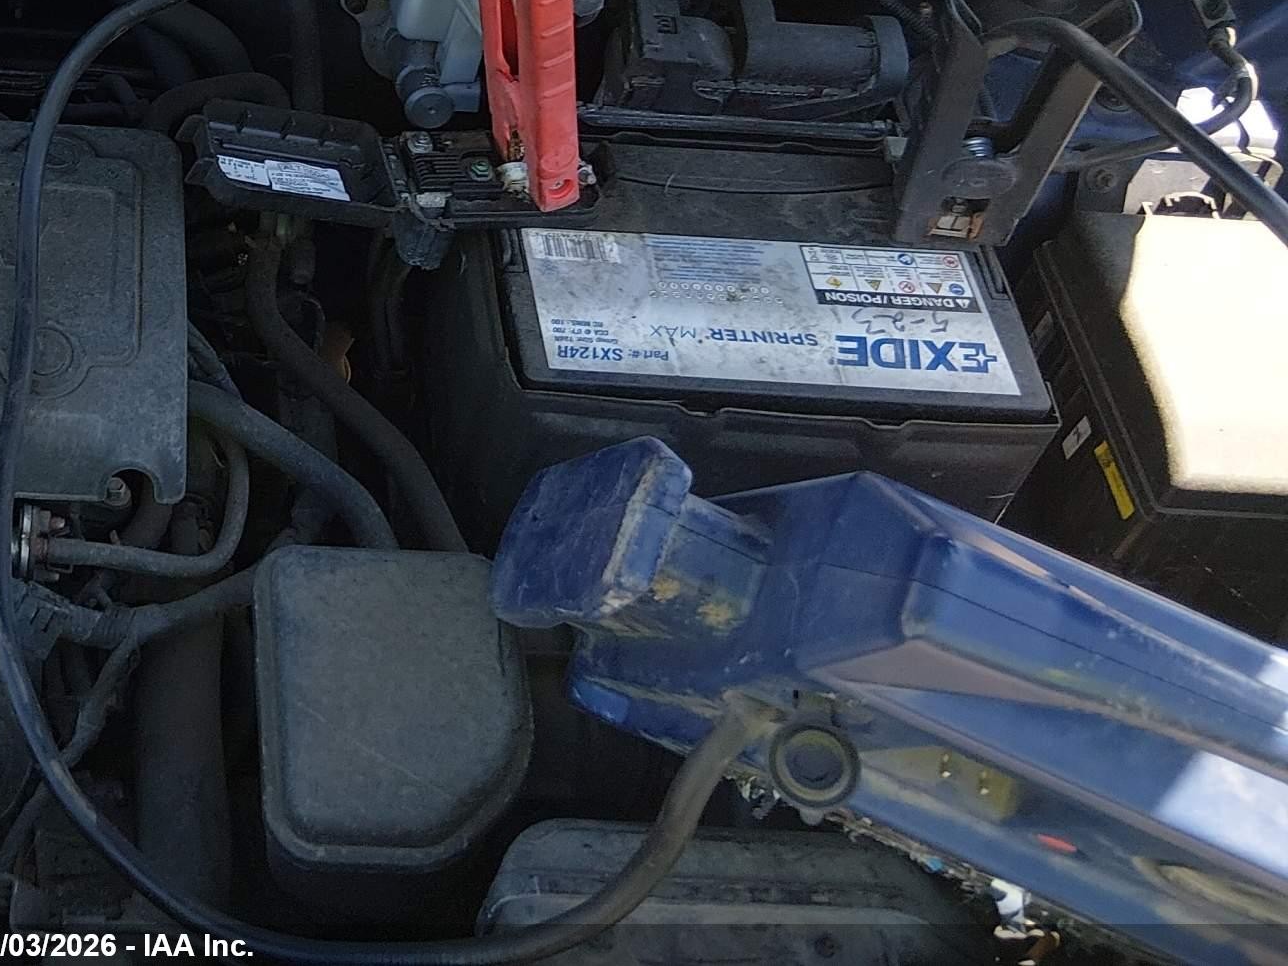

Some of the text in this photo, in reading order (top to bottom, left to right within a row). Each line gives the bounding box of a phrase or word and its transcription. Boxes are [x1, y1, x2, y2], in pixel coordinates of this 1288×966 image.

[825, 291, 883, 303] POISON
[890, 295, 955, 308] DANGER
[650, 325, 819, 347] SPRINTER MAX
[557, 345, 623, 361] SX124R
[644, 349, 669, 361] Part
[835, 335, 997, 374] EXIDE
